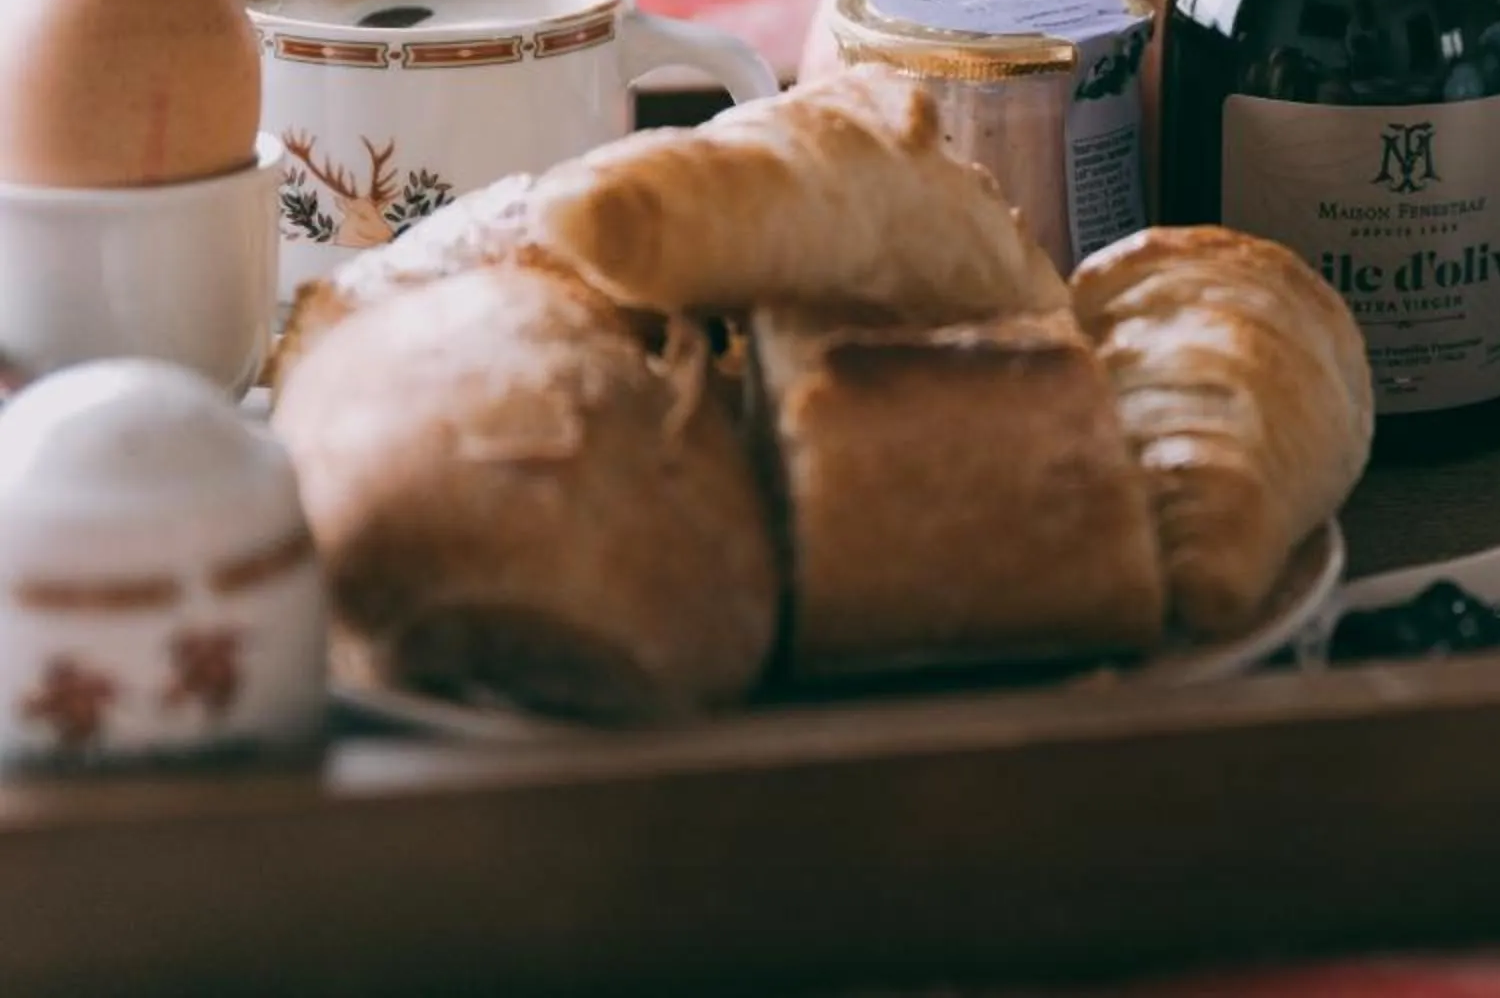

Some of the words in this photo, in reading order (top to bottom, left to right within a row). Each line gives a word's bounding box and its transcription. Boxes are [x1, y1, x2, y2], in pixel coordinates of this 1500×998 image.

[1317, 201, 1390, 220] MAISON
[1321, 252, 1383, 293] ile
[1345, 300, 1398, 313] XTRA
